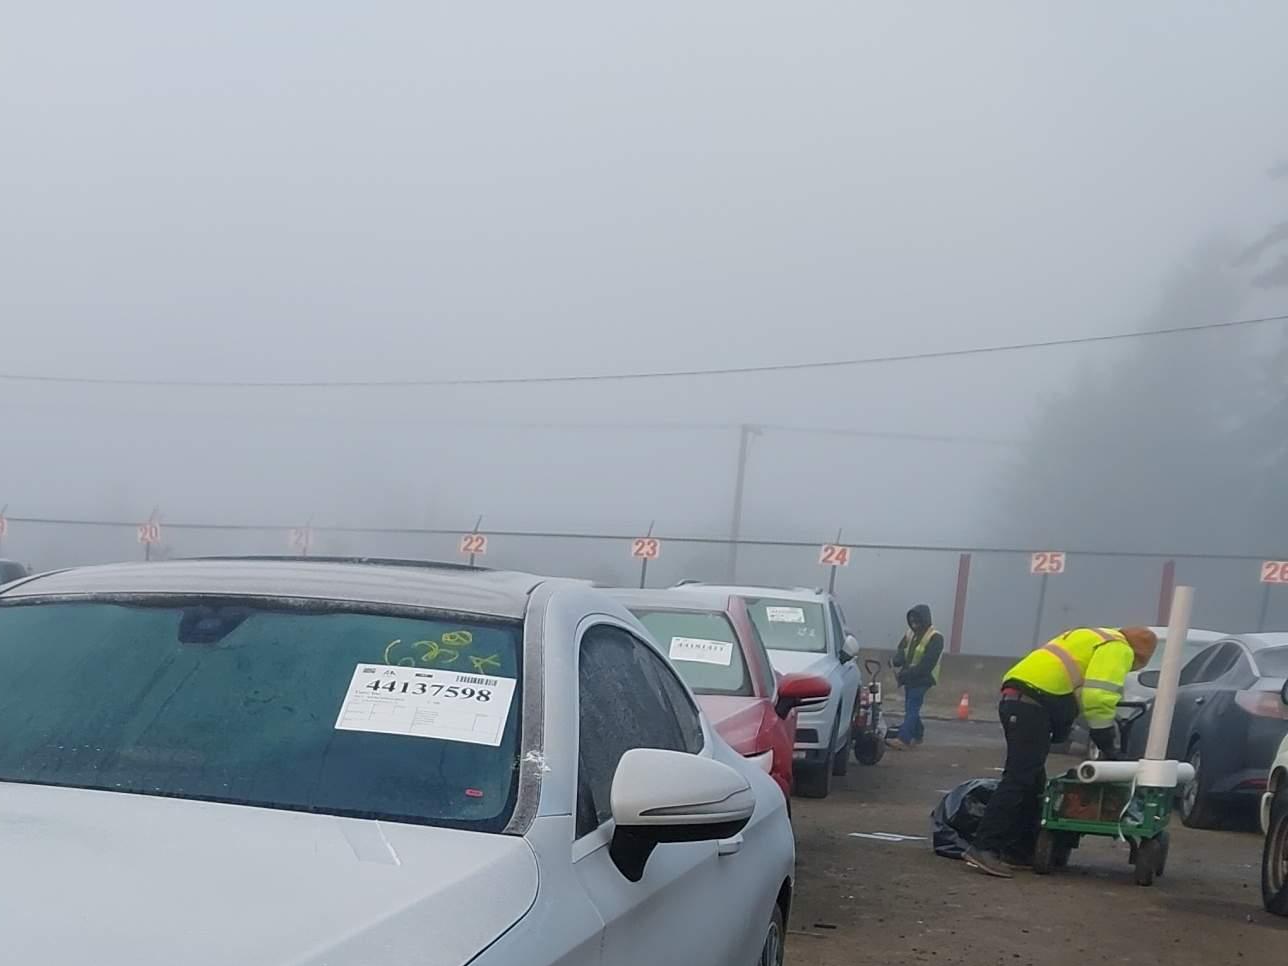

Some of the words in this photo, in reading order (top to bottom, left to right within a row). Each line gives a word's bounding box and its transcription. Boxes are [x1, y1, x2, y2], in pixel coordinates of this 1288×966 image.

[139, 524, 159, 542] 20
[294, 529, 312, 546] 21
[463, 535, 487, 554] 22
[634, 539, 659, 558] 23
[821, 545, 849, 565] 24
[1034, 554, 1063, 573] 25
[366, 680, 492, 703] 44137598
